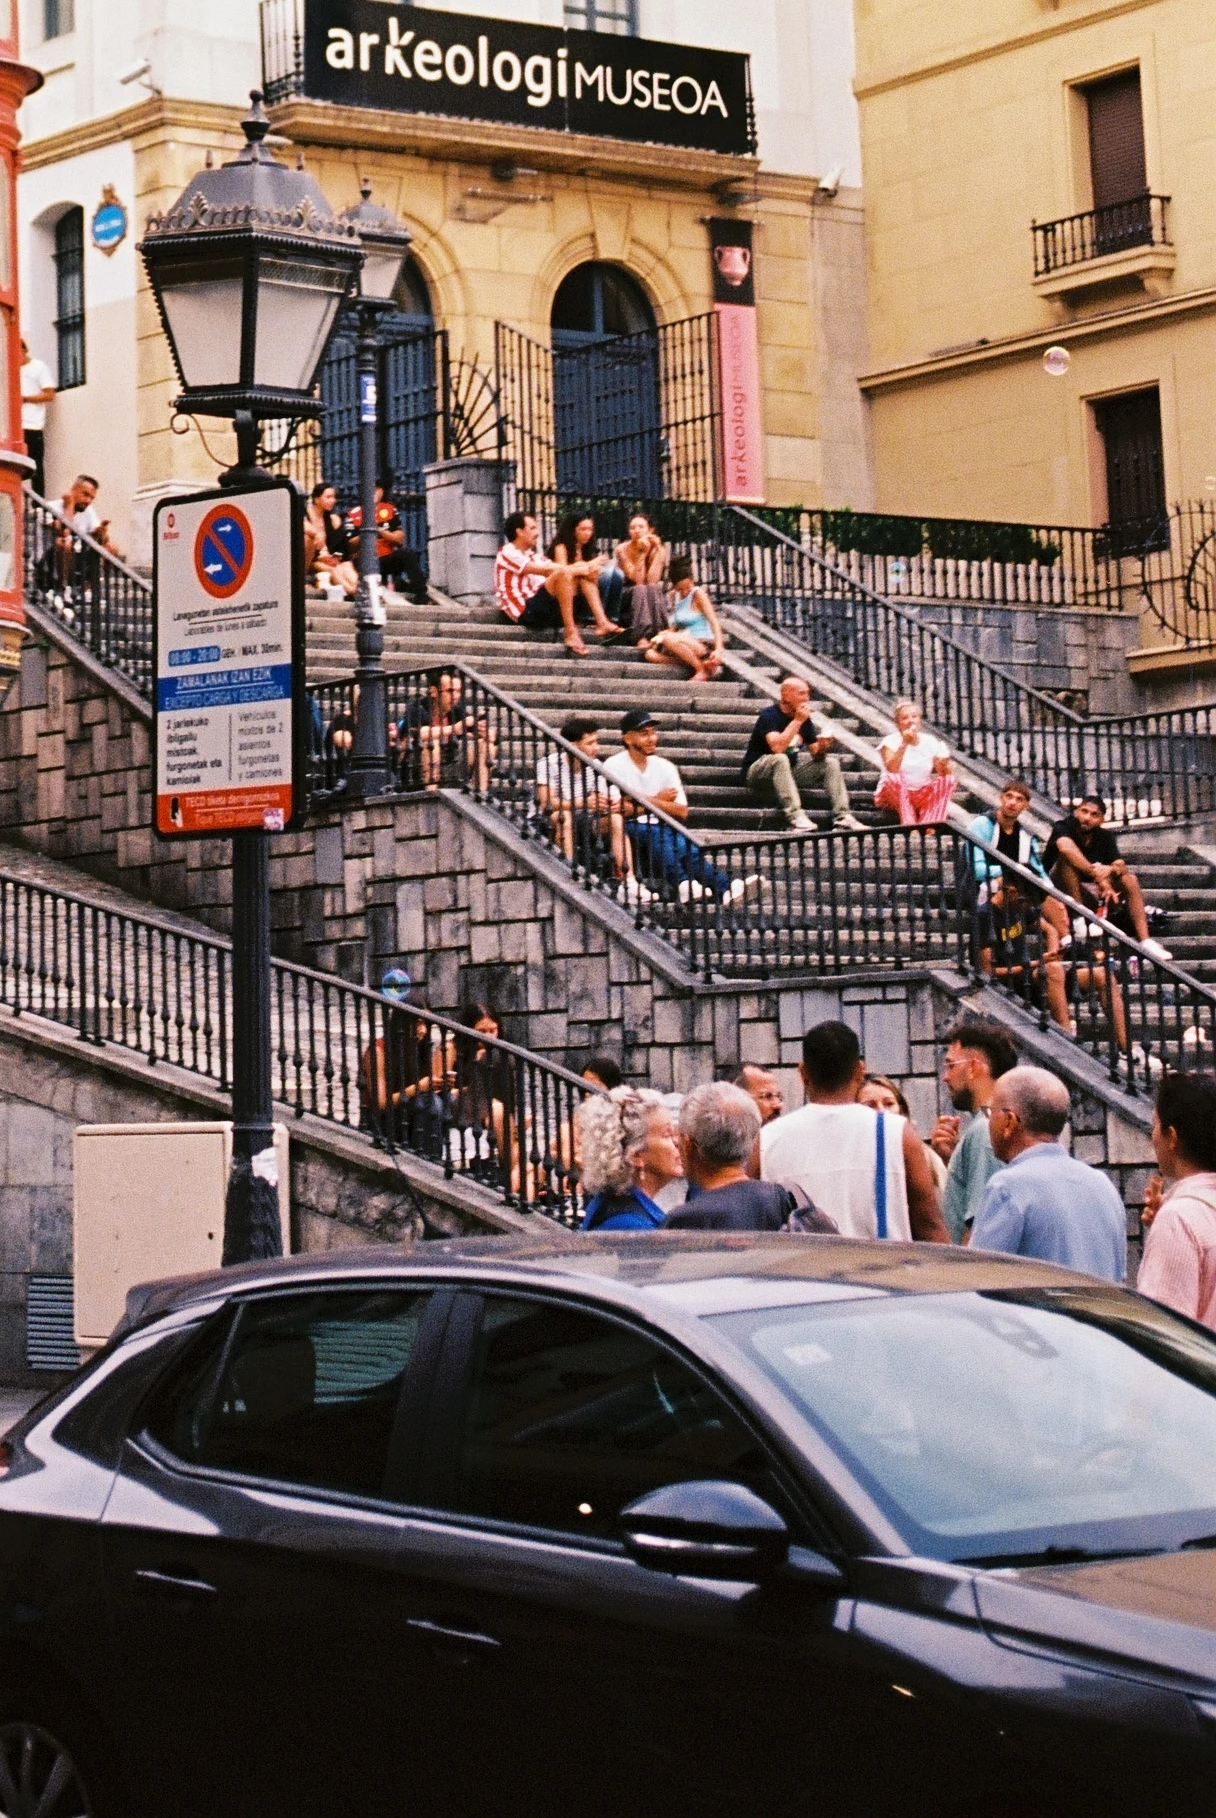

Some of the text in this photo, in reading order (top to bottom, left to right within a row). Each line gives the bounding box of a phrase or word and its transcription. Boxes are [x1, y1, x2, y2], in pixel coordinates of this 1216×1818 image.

[325, 16, 729, 119] arkeologi MUSEOA
[731, 385, 747, 487] arkeologi
